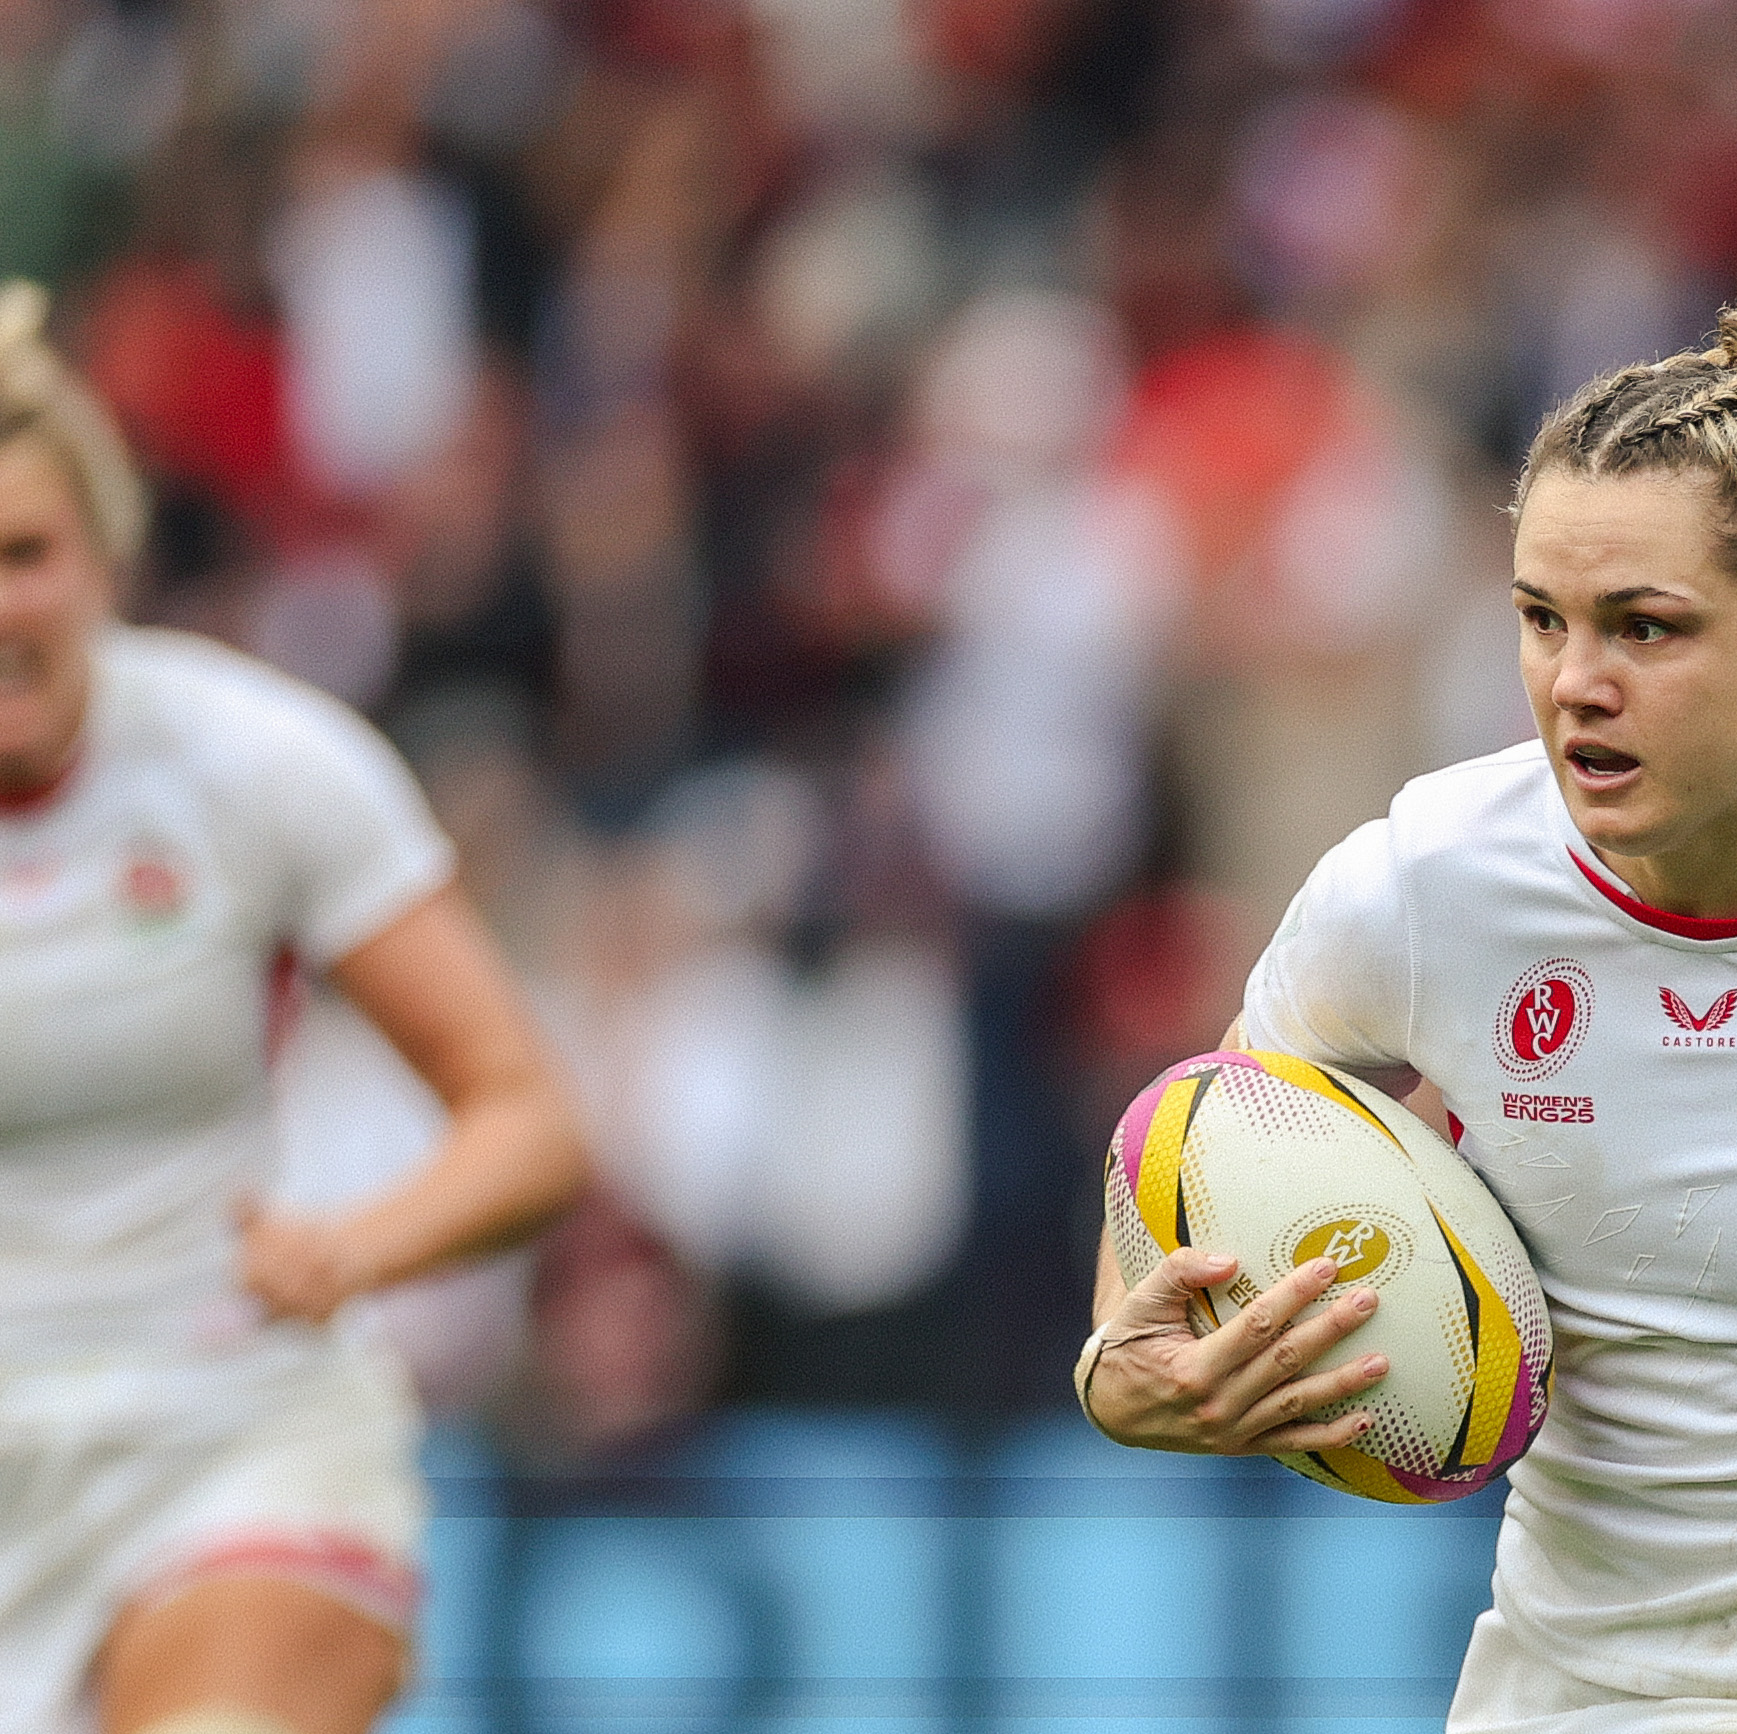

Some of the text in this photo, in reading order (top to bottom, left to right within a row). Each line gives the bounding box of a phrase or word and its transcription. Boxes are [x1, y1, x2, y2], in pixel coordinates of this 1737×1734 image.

[1525, 983, 1562, 1060] RWC
[1662, 1036, 1736, 1048] CASTORE
[1501, 1092, 1594, 1107] WOMEN'S
[1503, 1104, 1595, 1123] ENG25
